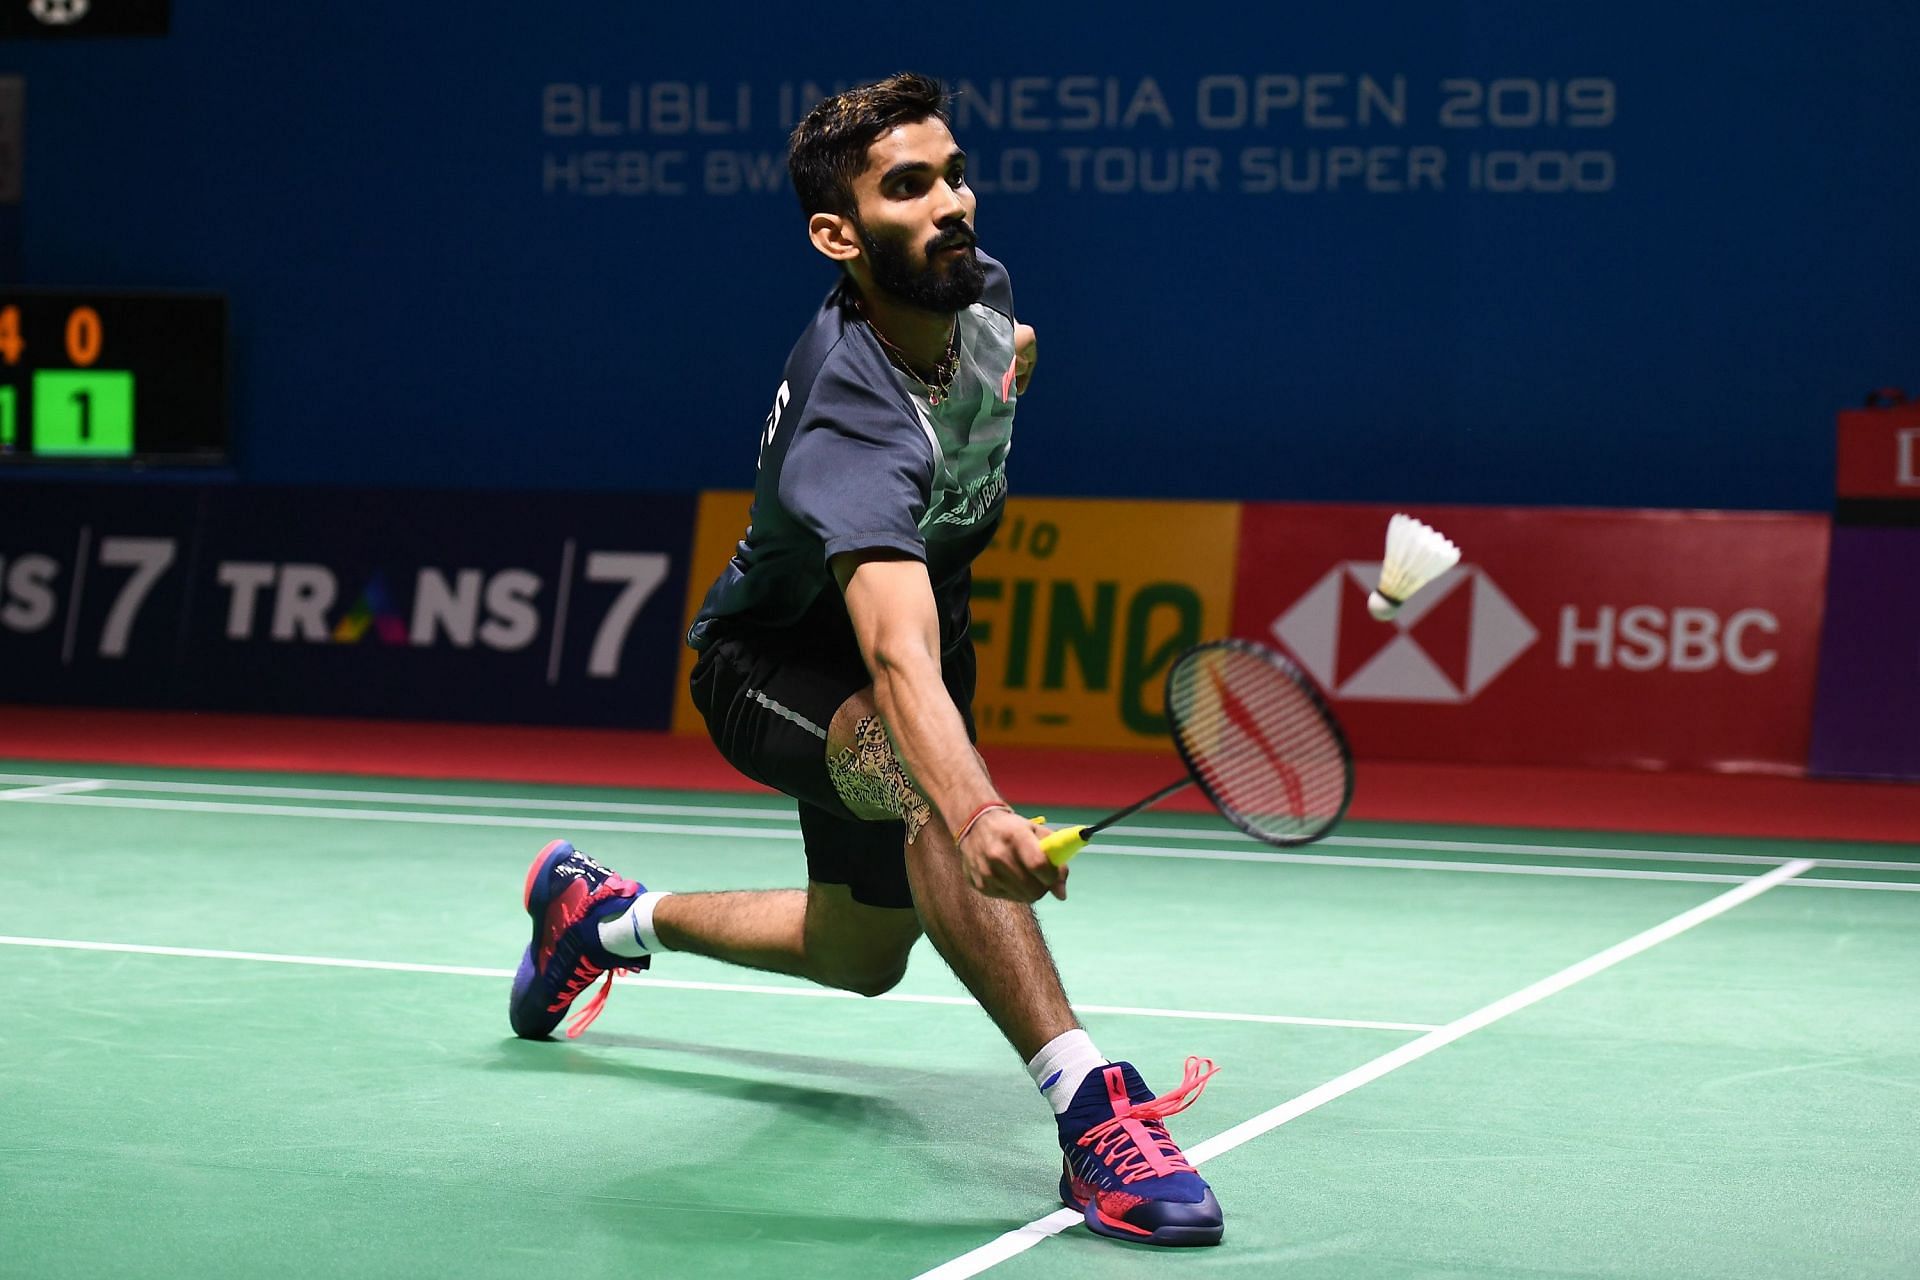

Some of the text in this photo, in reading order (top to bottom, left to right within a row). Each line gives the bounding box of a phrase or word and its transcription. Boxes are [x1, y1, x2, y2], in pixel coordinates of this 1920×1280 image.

[542, 81, 751, 136] BLIBLI
[1197, 73, 1406, 129] OPEN
[1440, 77, 1616, 129] 2019
[542, 149, 687, 196] HSBC
[704, 148, 794, 195] BW
[1059, 146, 1221, 193] TOUR
[1238, 145, 1446, 193] SUPER
[1468, 149, 1616, 193] 1000
[65, 306, 103, 366] 0
[70, 389, 93, 443] 1
[99, 536, 177, 657] 7
[216, 551, 670, 677] TRANS 7
[1556, 604, 1780, 676] HSBC
